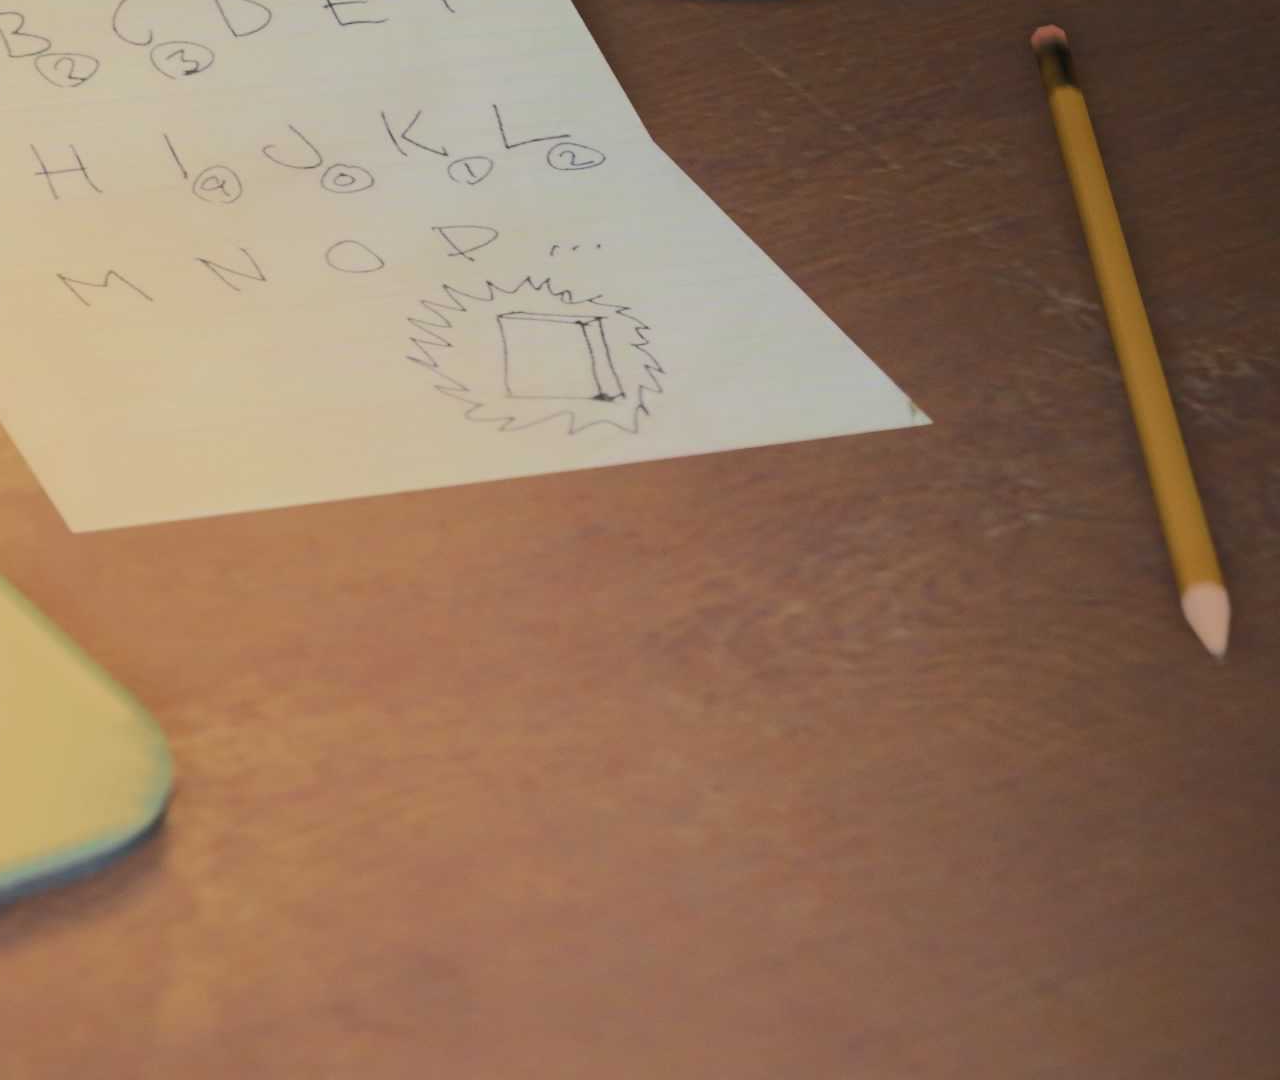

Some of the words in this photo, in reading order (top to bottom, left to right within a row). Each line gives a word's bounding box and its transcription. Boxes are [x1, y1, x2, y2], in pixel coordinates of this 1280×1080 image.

[31, 142, 103, 201] H
[261, 123, 324, 170] J
[380, 109, 449, 158] K
[492, 103, 572, 149] L
[57, 269, 154, 308] M
[196, 246, 267, 292] N
[325, 239, 385, 274] O
[430, 225, 500, 263] P
